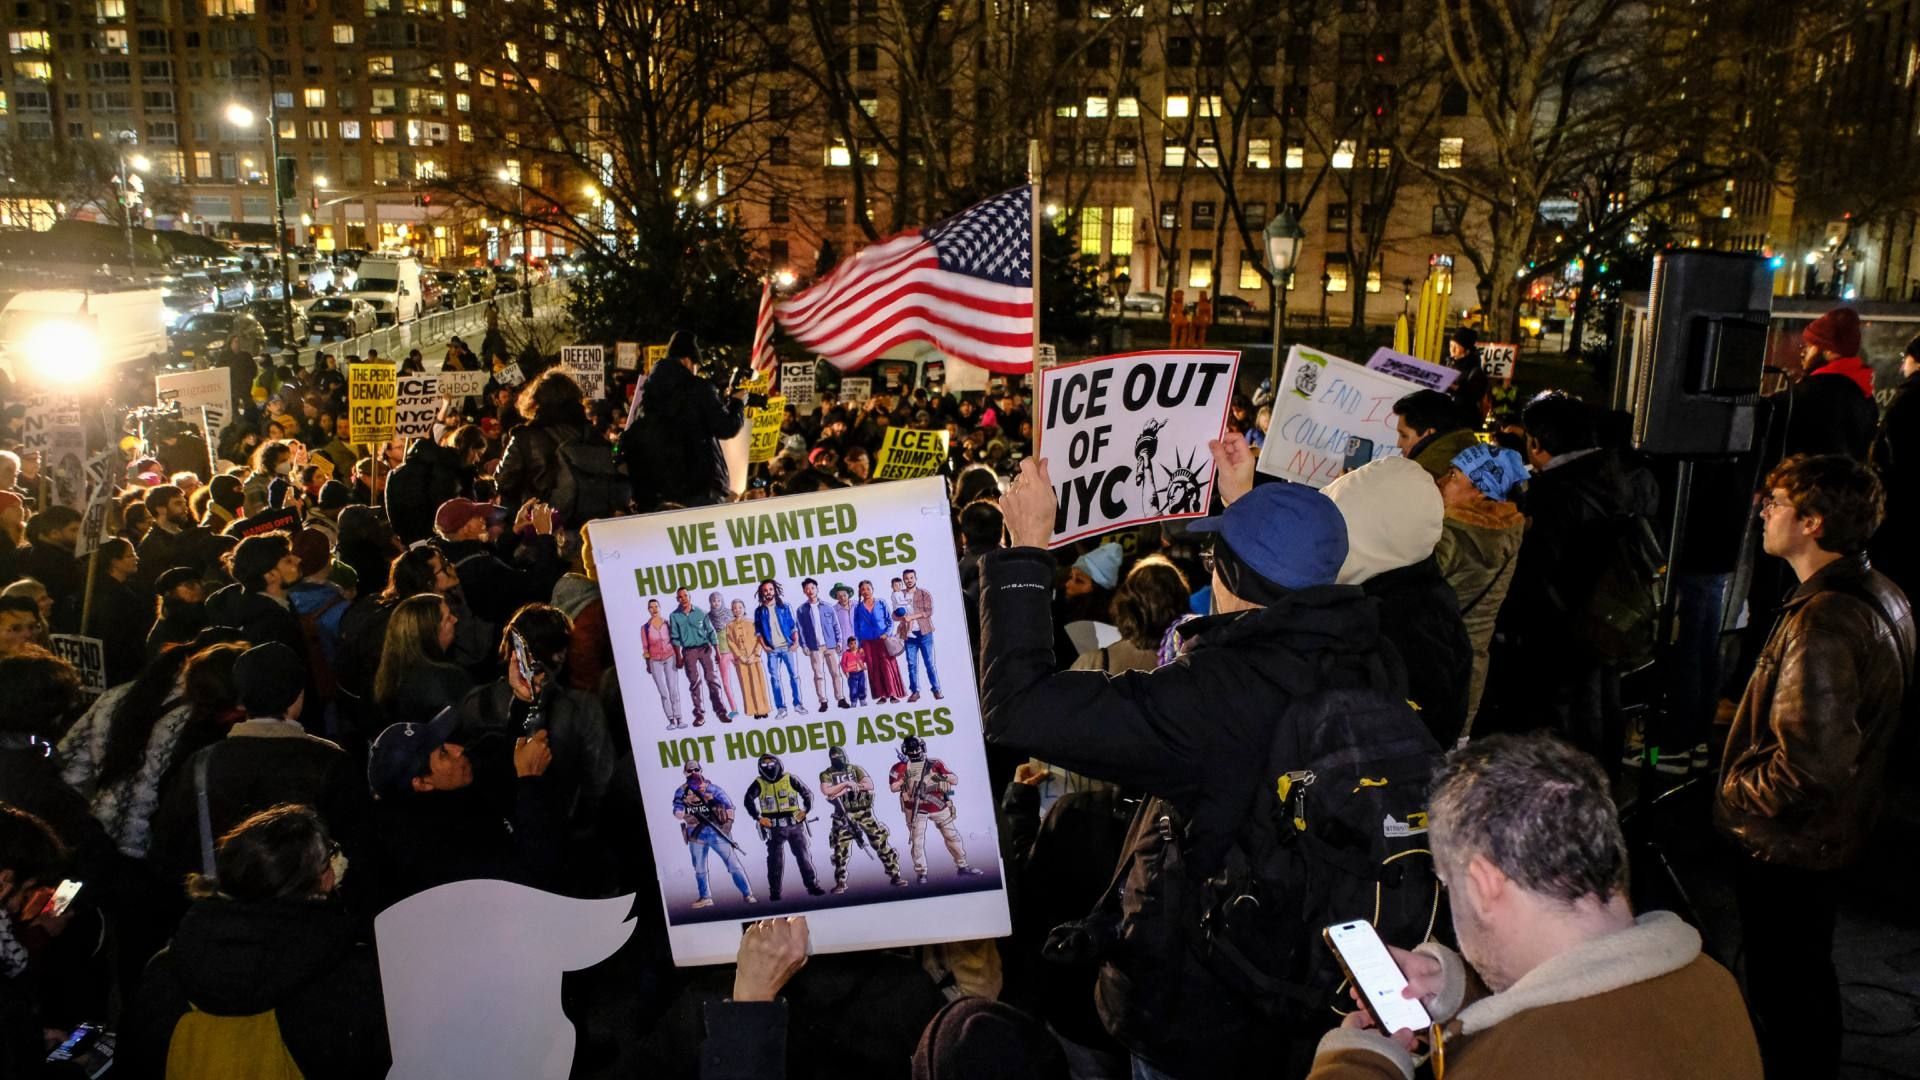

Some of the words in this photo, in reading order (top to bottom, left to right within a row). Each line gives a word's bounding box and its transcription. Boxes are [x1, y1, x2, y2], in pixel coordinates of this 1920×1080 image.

[564, 348, 601, 362] DEFEND
[352, 368, 368, 382] THE
[453, 373, 474, 381] THY
[783, 364, 813, 377] ICE
[1483, 363, 1505, 377] CE
[352, 383, 395, 400] DEMAND
[397, 379, 437, 396] ICE
[438, 382, 479, 394] GHBOR
[1046, 367, 1113, 430] ICE
[1122, 363, 1230, 411] OUT
[396, 397, 419, 406] OUT
[420, 396, 435, 405] OF
[1318, 379, 1362, 414] END
[1361, 396, 1397, 430] IC
[352, 406, 371, 425] ICE
[753, 412, 781, 428] EMAND
[751, 432, 761, 448] CE
[762, 430, 778, 447] OUT
[892, 429, 932, 451] ICE
[933, 434, 944, 452] IS
[1068, 424, 1112, 469] OF
[1282, 413, 1398, 462] COLLABAT
[887, 447, 944, 467] TRUMP'S
[880, 463, 937, 480] GESTAPO
[1051, 465, 1133, 535] NYC
[667, 521, 718, 556] WE
[727, 503, 858, 548] WANTED
[634, 551, 776, 597] HUDDLED
[786, 532, 918, 578] MASSES
[49, 637, 101, 670] EFEND
[657, 735, 717, 768] NOT
[724, 719, 847, 761] HOODED
[855, 706, 955, 747] ASSES
[686, 804, 710, 815] POIC
